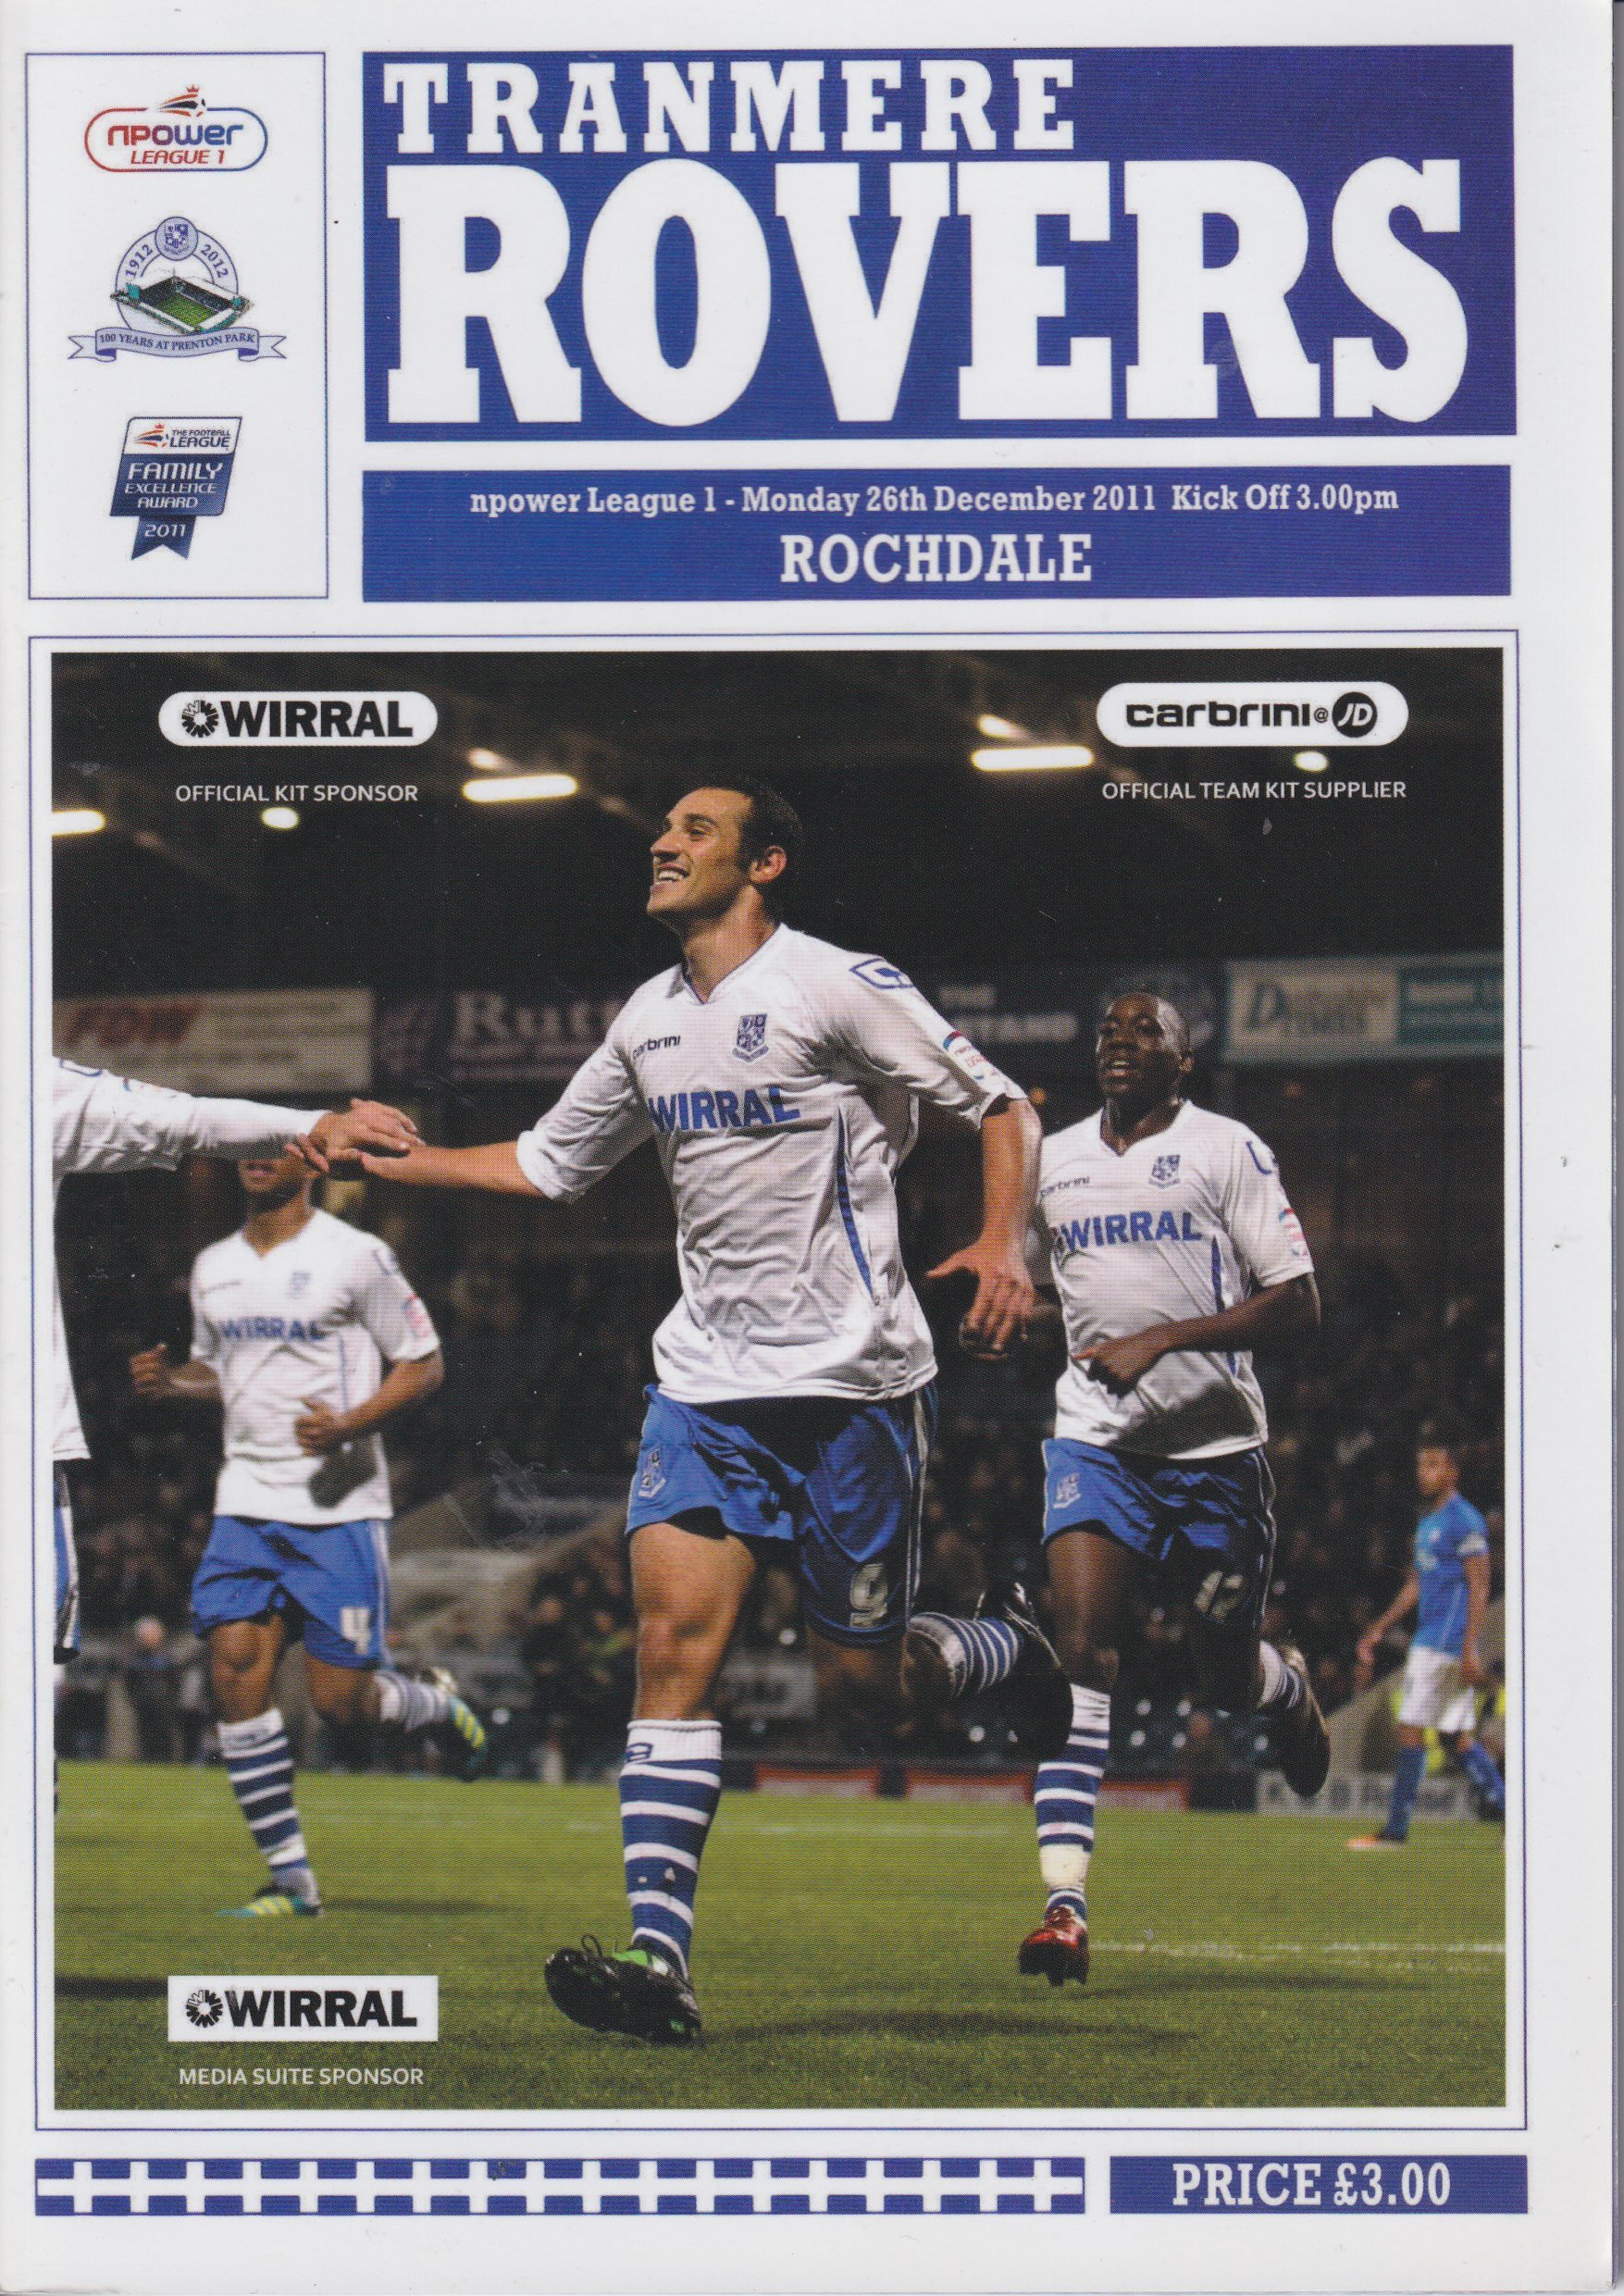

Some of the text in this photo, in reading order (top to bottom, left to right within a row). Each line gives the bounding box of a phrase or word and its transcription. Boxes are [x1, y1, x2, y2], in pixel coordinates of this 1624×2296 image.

[384, 59, 1073, 154] TRANMERE
[130, 149, 226, 165] LEAGUE 1
[125, 244, 153, 278] 1912
[201, 244, 229, 279] 2012
[386, 156, 1469, 427] ROVERS
[99, 333, 255, 351] 100 YEARS AT PRENTON PARK
[169, 437, 230, 448] LEAGUE
[124, 482, 218, 494] EXCELLENCE
[127, 462, 223, 480] FAMILY
[137, 496, 199, 509] AWARD
[470, 493, 581, 518] npower
[588, 487, 695, 518] League
[705, 487, 716, 512] 1
[742, 486, 860, 517] Monday
[866, 486, 927, 512] 26th
[934, 485, 1085, 512] December
[1093, 485, 1155, 511] 2011
[1172, 484, 1238, 511] Kick
[1245, 484, 1291, 510] Off
[1296, 483, 1398, 515] 3.00pm
[144, 524, 186, 538] 2011
[780, 533, 1092, 583] ROCHDALE
[220, 701, 414, 738] WIRRAL
[175, 785, 418, 802] OFFICIAL KIT SPONSOR
[1102, 781, 1406, 800] OFFICIAL TEAM KIT SUPPLIER
[649, 1086, 800, 1133] WIRRAL
[1060, 1210, 1203, 1252] WIRRAL
[217, 1316, 326, 1342] WIRRAL
[849, 1561, 888, 1629] 9
[341, 1606, 371, 1655] 4
[224, 1990, 417, 2028] WIRRAL
[180, 2067, 424, 2085] MEDIA SUITE SPONSOR
[1172, 2161, 1451, 2206] PRICE £3.00
